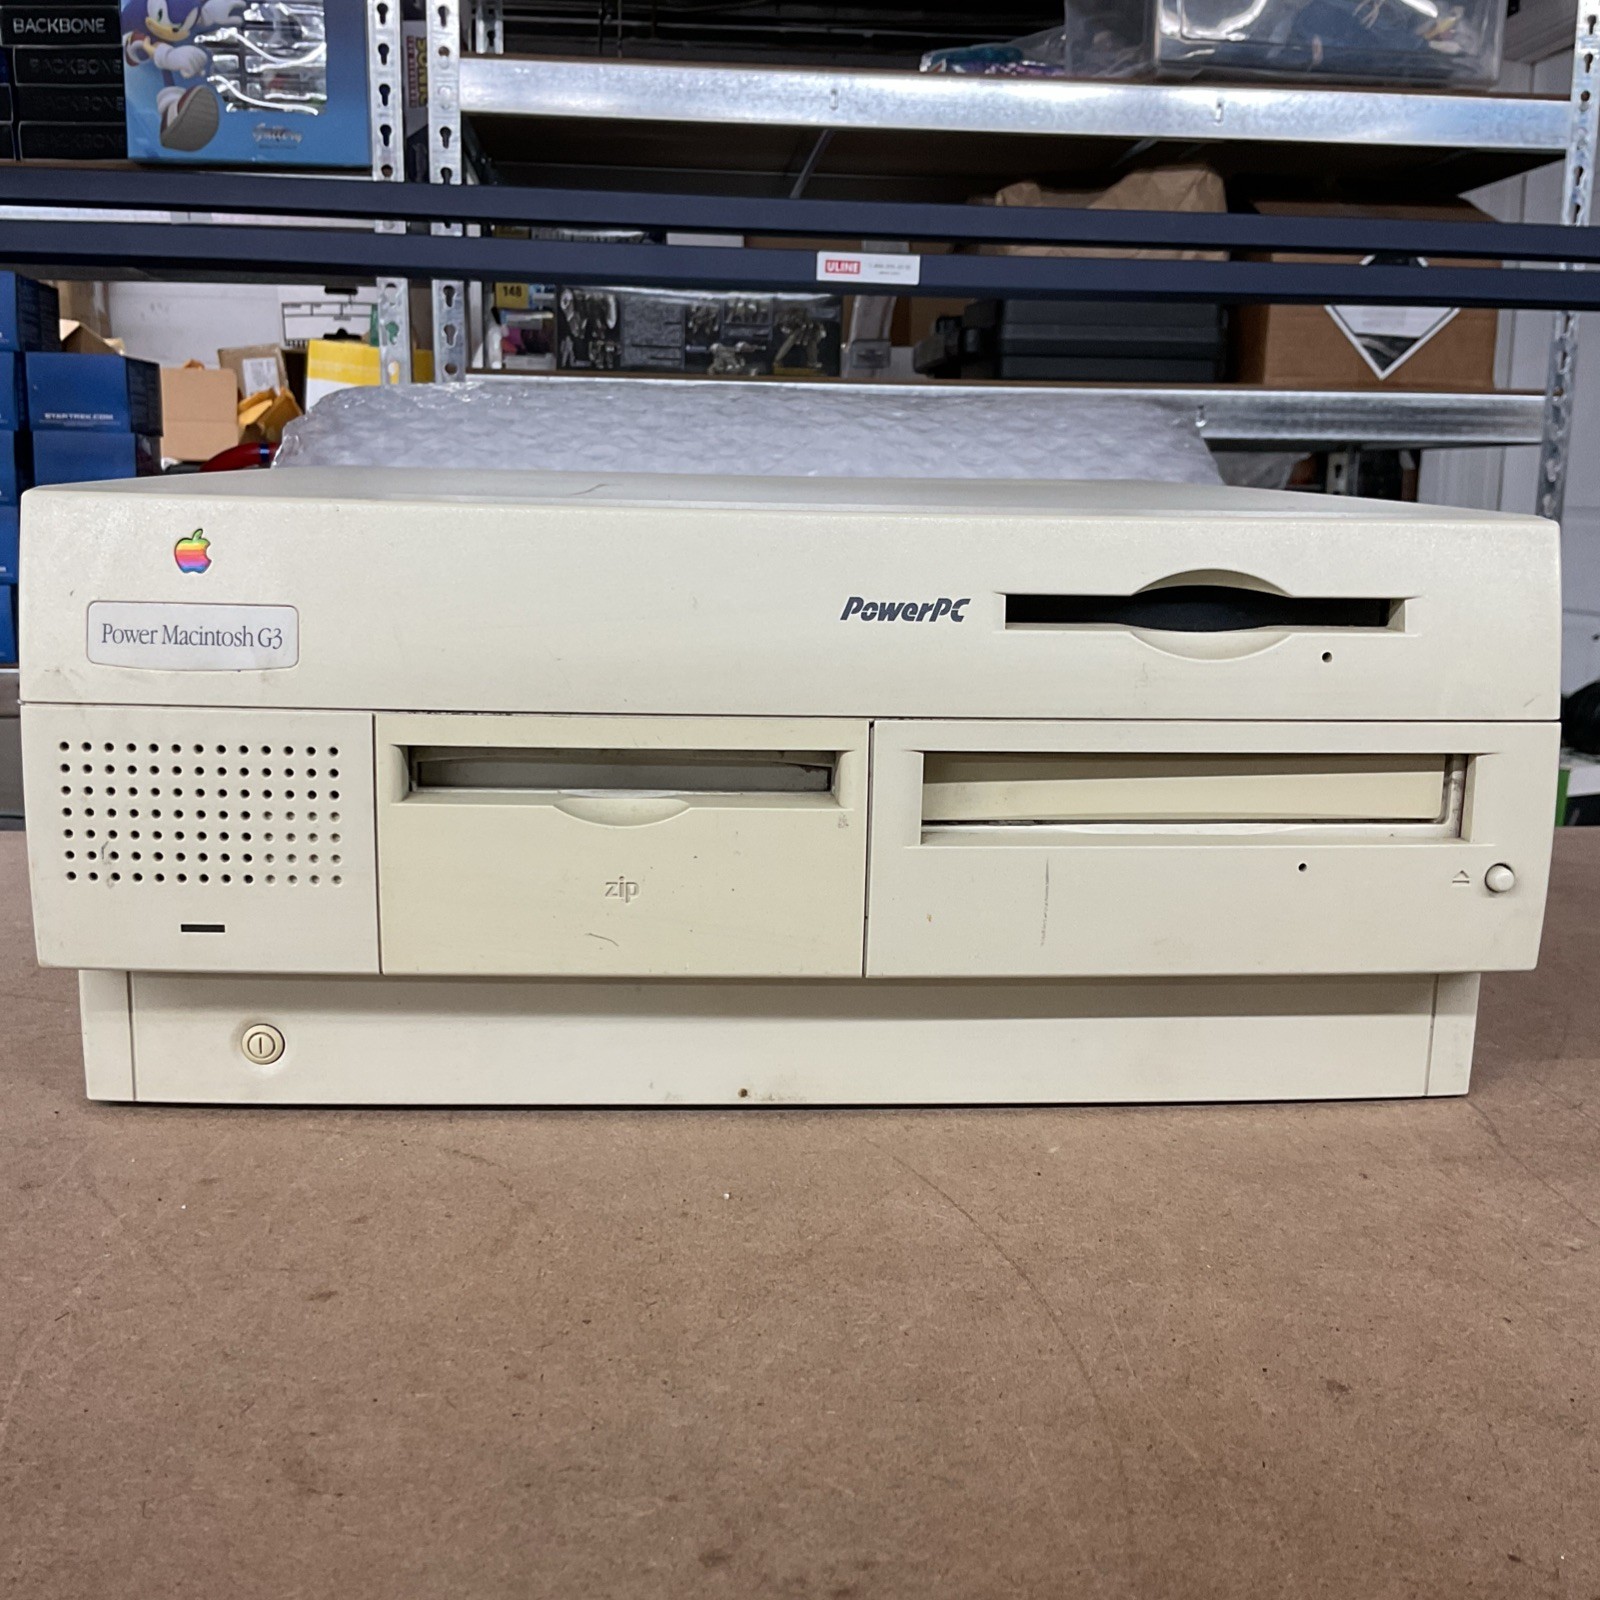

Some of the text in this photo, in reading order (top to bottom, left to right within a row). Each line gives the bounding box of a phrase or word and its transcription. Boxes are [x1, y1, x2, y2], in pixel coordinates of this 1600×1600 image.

[13, 17, 106, 34] BACKBONE
[826, 260, 859, 274] ULINE
[840, 596, 971, 622] PowerPC
[102, 623, 283, 650] Power Macintosh G3
[605, 875, 639, 903] zip
